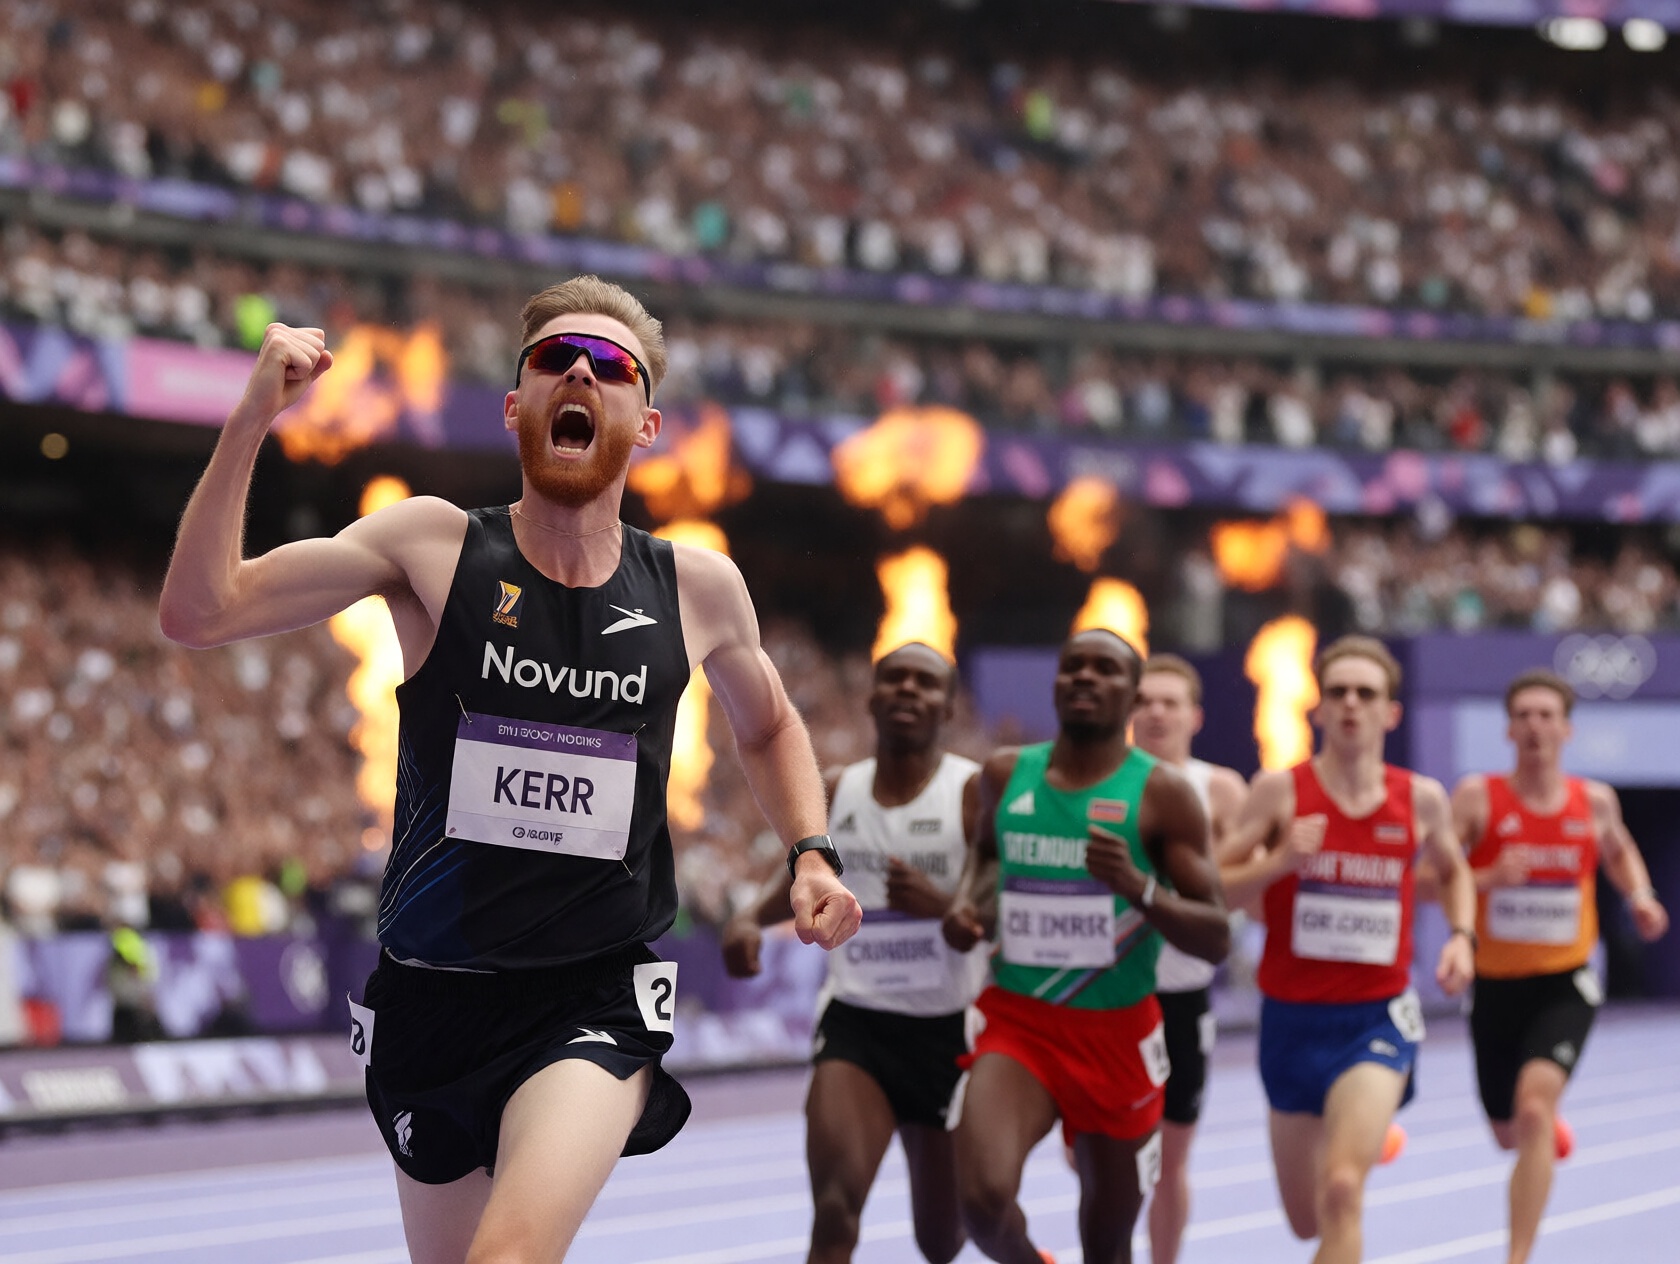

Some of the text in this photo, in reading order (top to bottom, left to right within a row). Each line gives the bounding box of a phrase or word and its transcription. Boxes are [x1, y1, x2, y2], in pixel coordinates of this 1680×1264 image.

[481, 641, 648, 705] Novund
[493, 766, 595, 816] KERR
[650, 977, 672, 1021] 2
